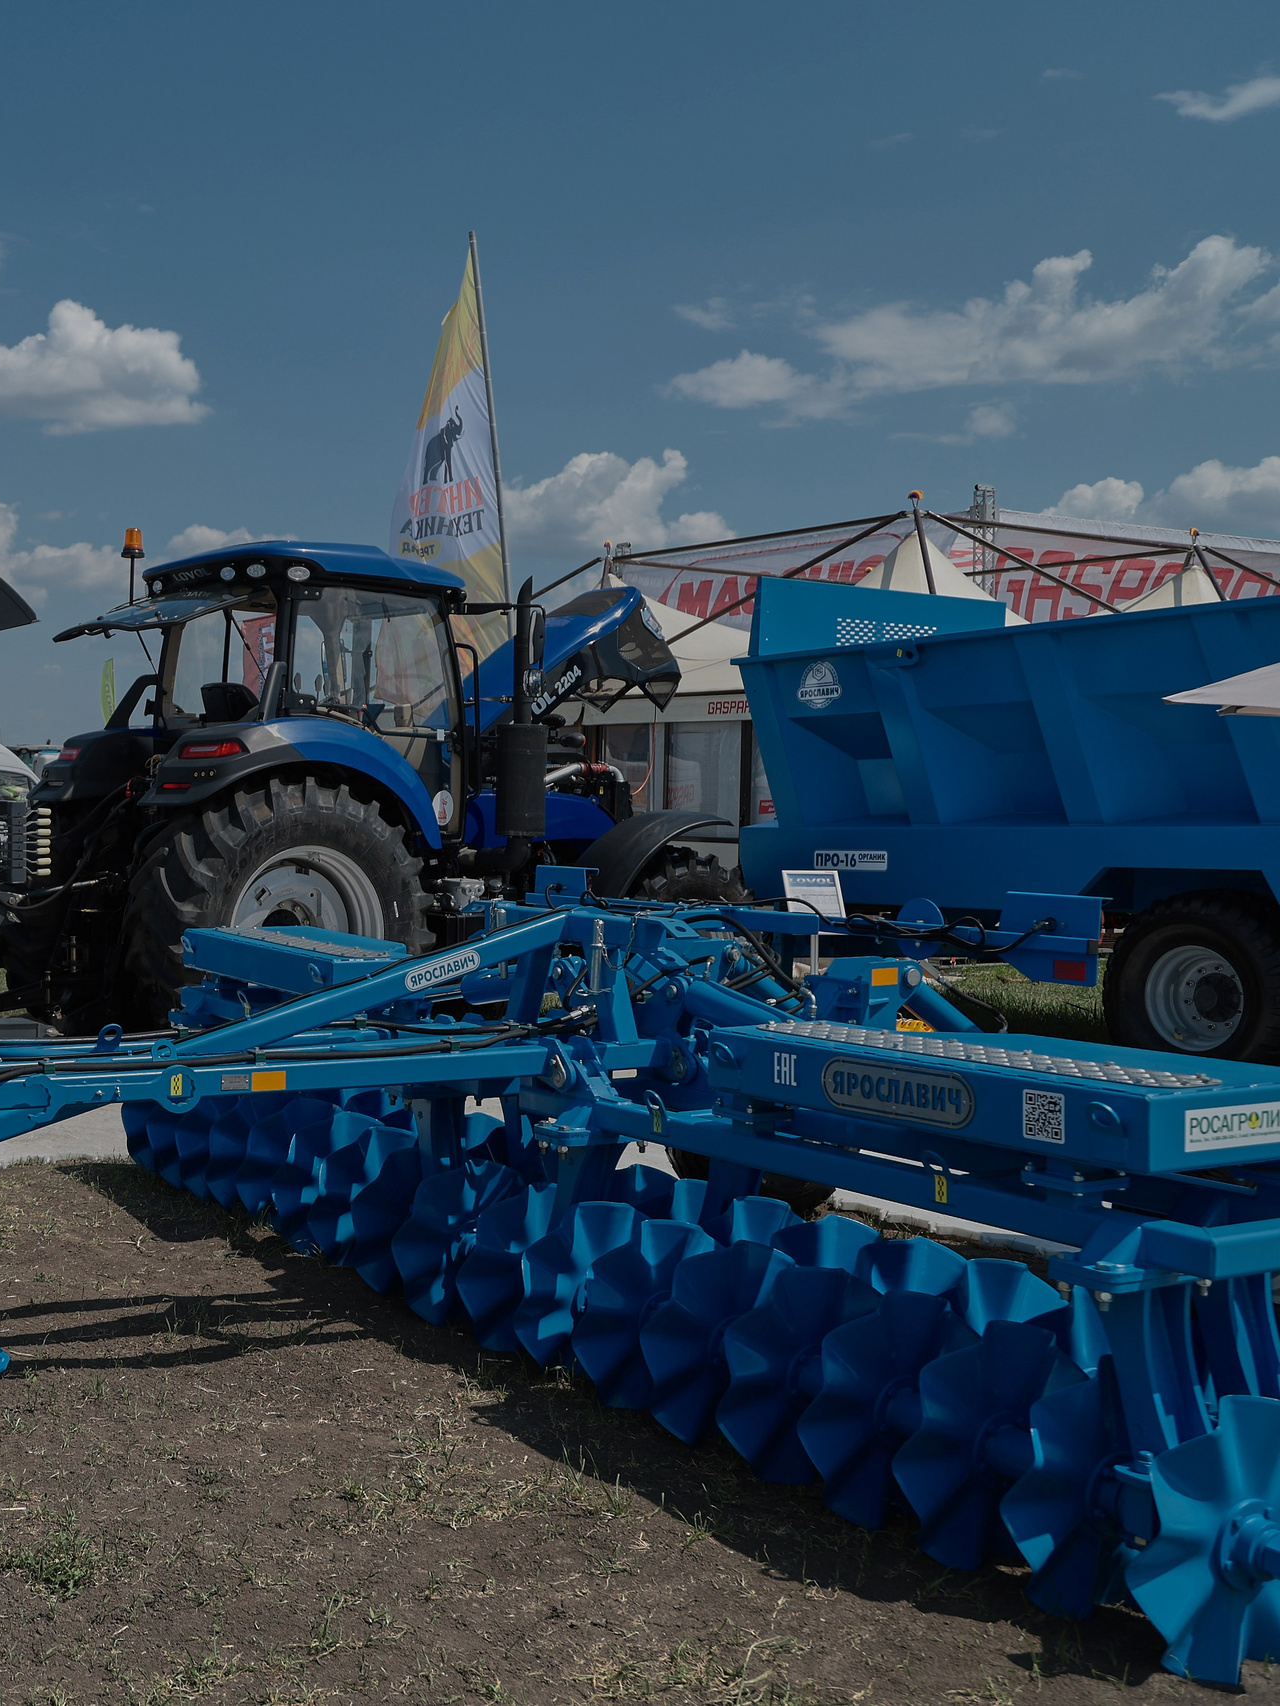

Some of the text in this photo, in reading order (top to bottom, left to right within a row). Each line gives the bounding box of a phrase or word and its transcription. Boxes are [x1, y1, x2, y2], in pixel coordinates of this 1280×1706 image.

[173, 568, 212, 582] LOVOL
[554, 665, 582, 695] 2204
[800, 686, 839, 699] ЯРОСЛАВИЧ
[708, 700, 751, 715] GASPAR
[815, 852, 886, 868] ПРО-16 ОРГАНИК
[790, 877, 834, 885] LOVOL
[410, 954, 476, 988] ЯРОСЛАВИЧ
[832, 1070, 962, 1115] ЯРОСЛАВИЧ
